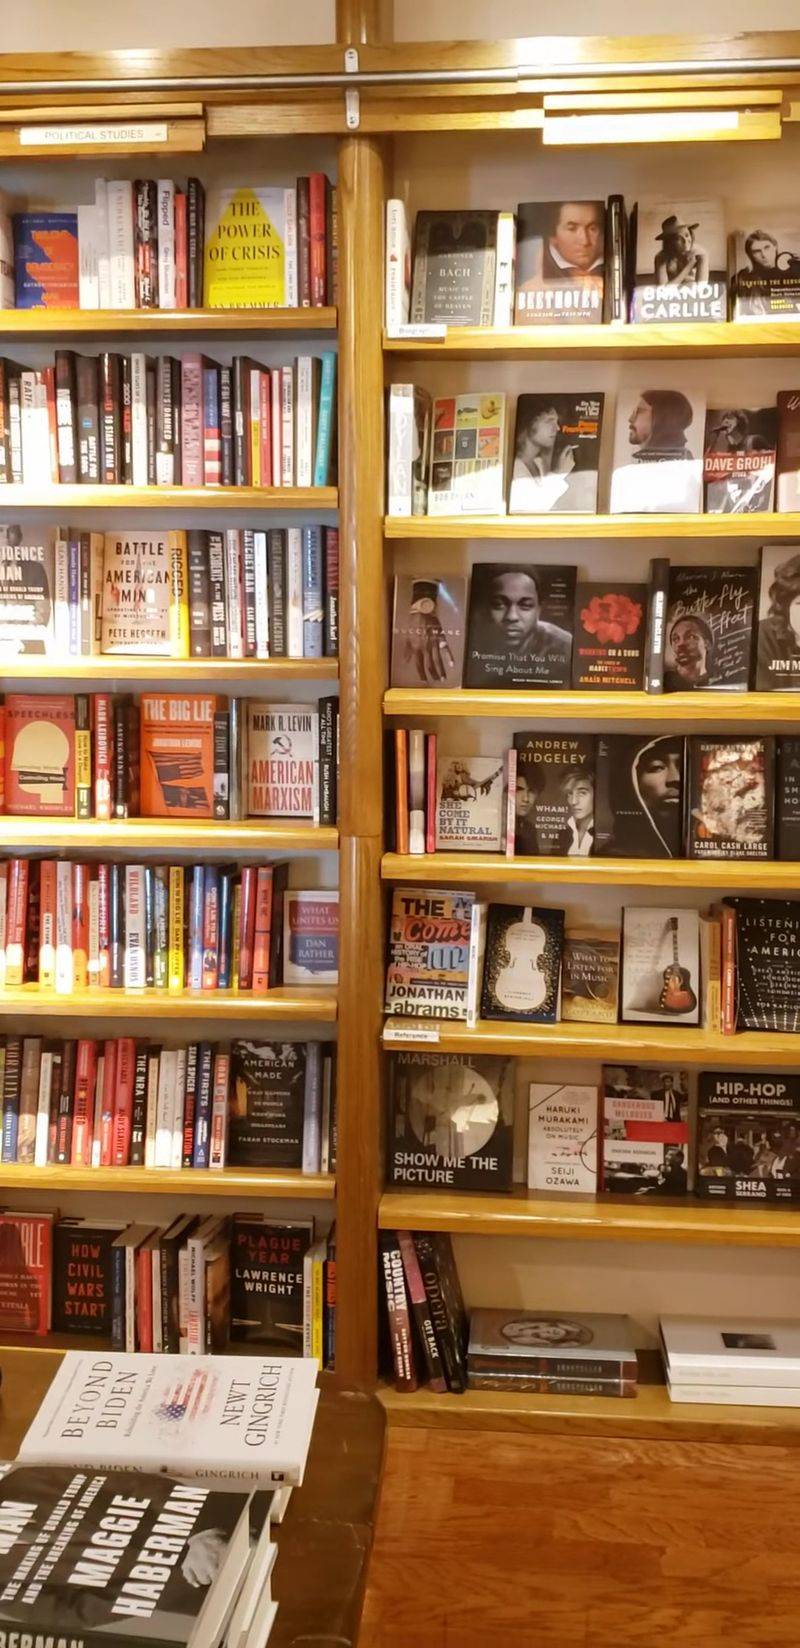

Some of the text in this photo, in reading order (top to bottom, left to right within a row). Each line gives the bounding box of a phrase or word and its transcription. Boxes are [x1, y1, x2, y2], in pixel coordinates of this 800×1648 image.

[45, 129, 144, 140] POLITICAL STUDIES
[162, 190, 170, 226] Flipped
[230, 202, 260, 216] THE
[218, 224, 271, 239] POWER
[209, 245, 280, 261] OF CRISIS
[439, 268, 471, 277] BACH
[518, 290, 598, 310] BEETHOVEN
[643, 284, 719, 301] BRANDI
[641, 301, 721, 319] CARLILE
[222, 402, 230, 417] WAY
[105, 415, 113, 424] TO
[105, 426, 113, 446] START
[106, 454, 114, 468] WAR
[705, 456, 772, 471] DAVE GROHL
[115, 542, 164, 556] BATTLE
[244, 530, 254, 570] HATCHET
[172, 548, 183, 598] RIGGED
[706, 605, 754, 634] Effect
[472, 651, 566, 663] Promise That You Will
[485, 663, 549, 676] Sing About Me
[8, 710, 75, 719] SPEECHLESS
[143, 699, 213, 721] THE BIG LIE
[252, 715, 311, 731] MARK R. LEVIN
[98, 700, 108, 764] MARK LEIBOVICH
[527, 741, 579, 750] ANDREW
[519, 753, 586, 764] RIDGELEY
[251, 760, 314, 785] AMERICAN
[252, 787, 312, 811] MARXISM
[439, 801, 462, 810] SHE
[439, 810, 470, 819] COME
[536, 805, 569, 813] WHAM!
[439, 826, 492, 835] NATURAL
[694, 841, 719, 849] CAROL
[744, 842, 767, 850] LARGE
[129, 871, 139, 915] WILDLAND
[301, 906, 330, 915] WHAT
[401, 897, 445, 917] THE
[404, 920, 471, 942] Come
[770, 933, 796, 943] FOR
[129, 932, 140, 954] EVAN
[305, 939, 326, 948] DAN
[298, 949, 334, 959] RATHER
[567, 962, 595, 972] LISTEN
[581, 972, 608, 982] MUSIC
[389, 986, 465, 1002] JONATHAN
[394, 1001, 459, 1018] abrams
[243, 1060, 295, 1068] AMERICAN
[397, 1053, 475, 1068] MARSHALL
[136, 1054, 146, 1096] THE NRA
[187, 1046, 197, 1092] SEAN SPICER
[254, 1072, 283, 1080] MADE
[201, 1050, 211, 1106] THE FIRSTS
[716, 1082, 786, 1097] HIP-HOP
[612, 1101, 656, 1110] DANGEROUS
[760, 1098, 793, 1106] THINGS)
[546, 1106, 581, 1114] HARUKI
[615, 1110, 652, 1119] MELODIES
[538, 1116, 589, 1125] MURAKAMI
[117, 1109, 126, 1152] ANDY SLAVITT
[263, 1136, 299, 1144] STOCKMAN
[394, 1152, 498, 1171] SHOW ME THE
[394, 1168, 454, 1183] PICTURE
[551, 1167, 575, 1176] SEIJI
[546, 1177, 580, 1186] OZAWA
[736, 1180, 766, 1191] SHEA
[237, 1234, 299, 1250] PLAGUE
[71, 1243, 101, 1258] HOW
[250, 1251, 289, 1264] YEAR
[67, 1262, 104, 1277] CIVIL
[236, 1268, 303, 1284] LAWRENCE
[382, 1252, 395, 1312] MUSIC
[390, 1250, 408, 1311] COUNTRY
[67, 1282, 104, 1298] WARS
[244, 1282, 294, 1295] WRIGHT
[65, 1301, 106, 1316] START
[424, 1272, 448, 1333] opera
[423, 1319, 439, 1359] GET BACK
[61, 1361, 113, 1437] BEYOND
[96, 1372, 138, 1428] BIDEN
[220, 1379, 250, 1426] NEWT
[245, 1365, 282, 1446] GINGRICH
[196, 1469, 259, 1480] GINGRICH
[0, 1473, 87, 1601] THE MAKING OF DONALD TRUMP
[21, 1476, 107, 1604] AND THE BREAKING OF AMERICA
[67, 1494, 152, 1589] MAGGIE
[110, 1484, 211, 1618] HABERMAN
